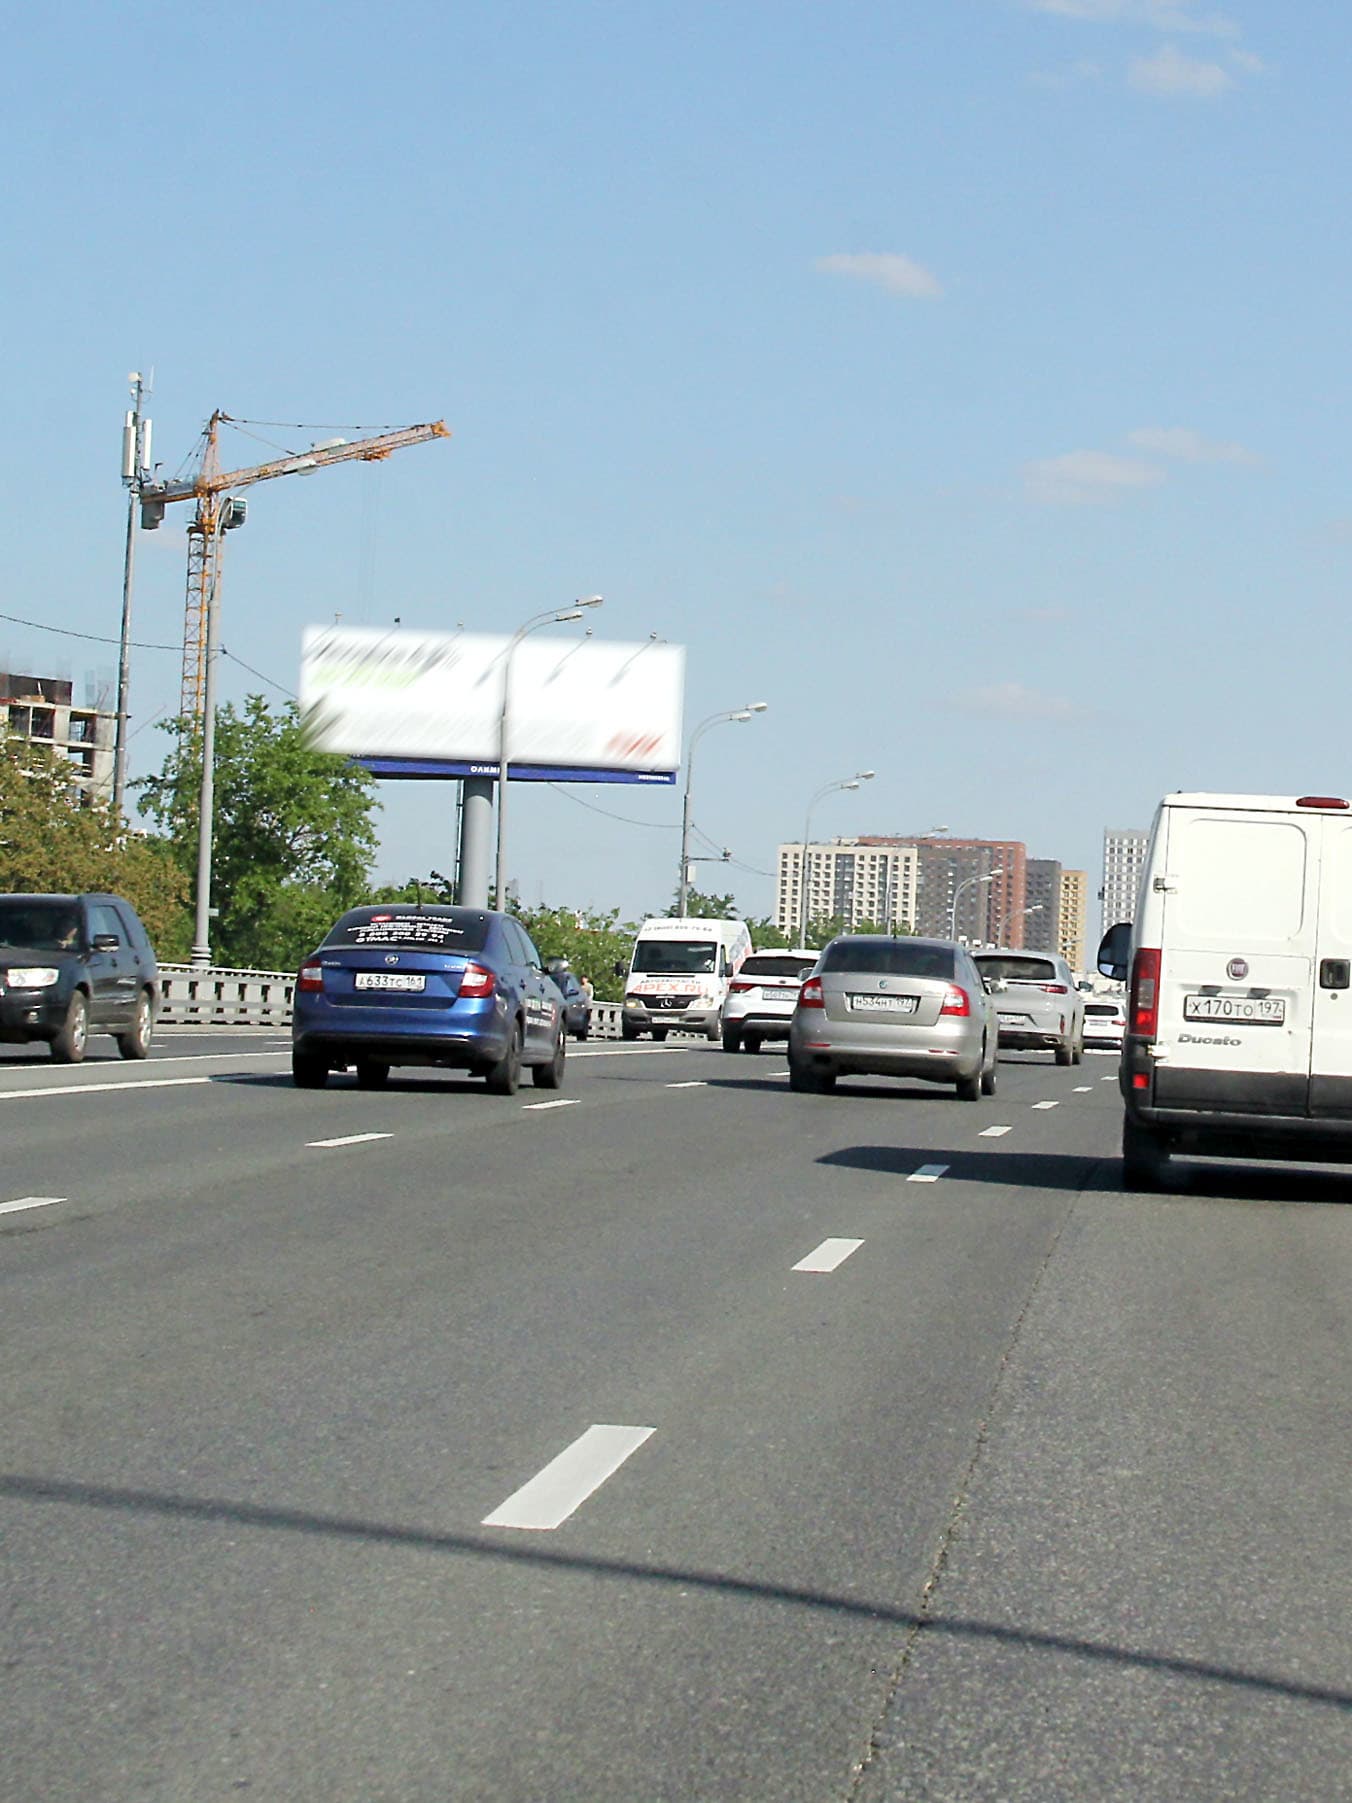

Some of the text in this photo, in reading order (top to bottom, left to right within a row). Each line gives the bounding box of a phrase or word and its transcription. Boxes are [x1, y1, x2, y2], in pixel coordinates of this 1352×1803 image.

[1191, 999, 1280, 1017] Х170ТО 197
[1177, 1033, 1243, 1047] Ducato
